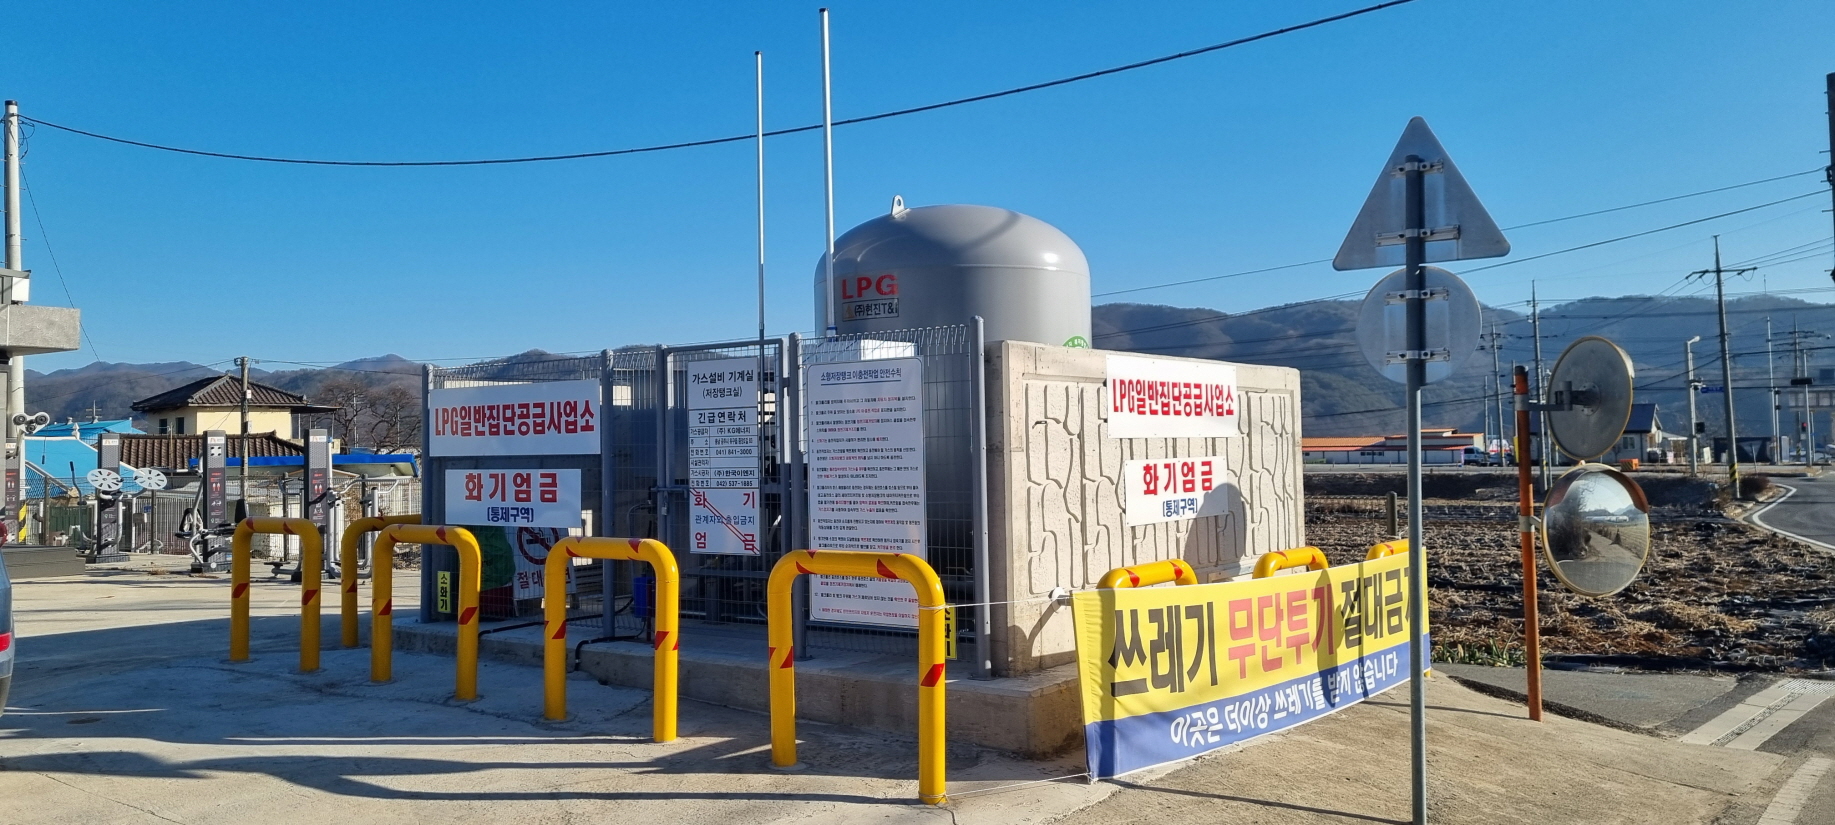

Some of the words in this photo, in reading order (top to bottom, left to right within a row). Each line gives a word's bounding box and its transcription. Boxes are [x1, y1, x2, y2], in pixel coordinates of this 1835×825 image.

[842, 274, 898, 299] LPG
[692, 371, 725, 384] 가스설비
[728, 370, 754, 382] 기계실
[1112, 378, 1234, 417] LPG일반집단공급사업소
[434, 399, 595, 437] LPG일반집단공급사업소
[698, 411, 746, 424] 긴급연락처
[487, 506, 534, 523] (통제구역)
[440, 573, 448, 611] 소화기
[1108, 601, 1218, 698] 쓰레기
[1227, 583, 1334, 679] 무단투기
[1340, 566, 1410, 650] 절대금
[1170, 706, 1224, 748] 이곳은
[1273, 677, 1326, 720] 쓰레기를
[1327, 667, 1351, 704] 받지
[1352, 650, 1399, 695] 않습니다
